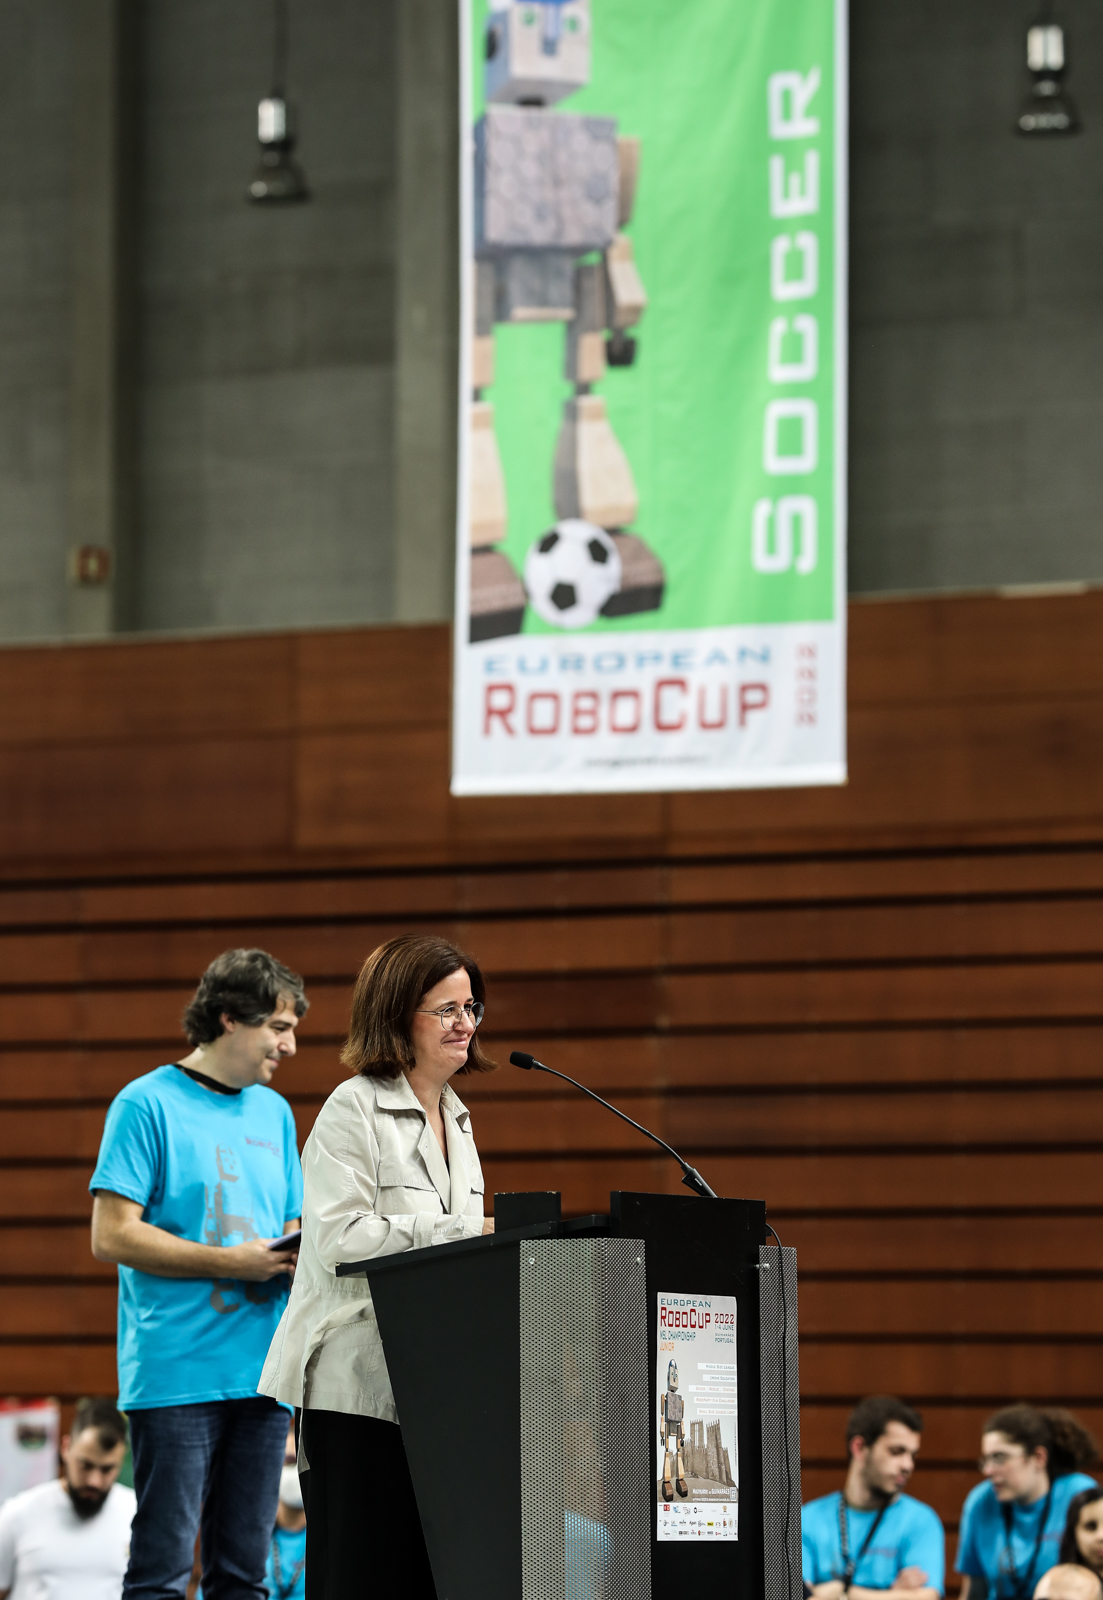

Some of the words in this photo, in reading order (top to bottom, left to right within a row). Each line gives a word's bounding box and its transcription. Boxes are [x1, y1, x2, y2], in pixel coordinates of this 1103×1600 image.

[752, 65, 821, 574] SOCCER
[484, 646, 770, 675] EUROPEAN
[483, 677, 769, 738] ROBOCUP
[660, 1298, 711, 1308] EUROPEAN
[660, 1306, 711, 1329] ROBOCUP
[714, 1313, 735, 1324] 2022
[668, 1330, 696, 1341] CHAMPIONSHIP
[660, 1342, 674, 1351] JUNIOR
